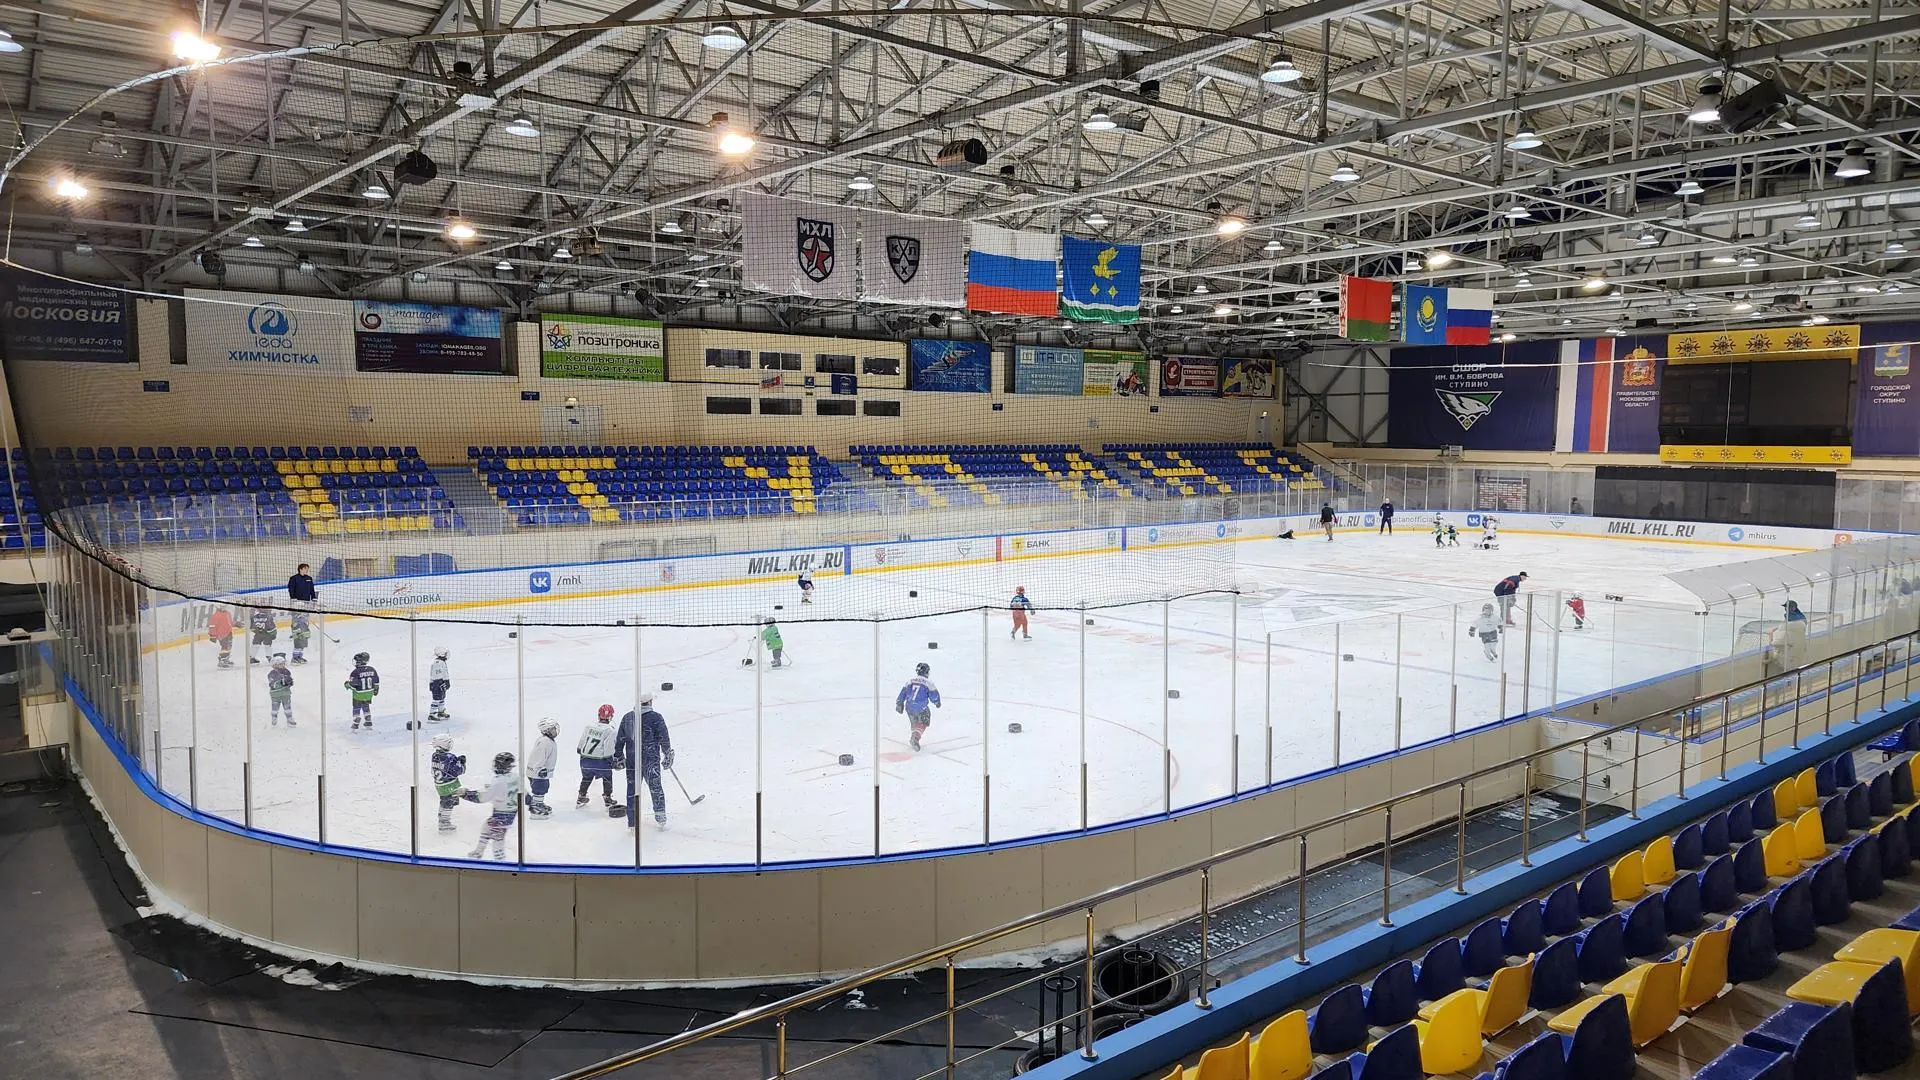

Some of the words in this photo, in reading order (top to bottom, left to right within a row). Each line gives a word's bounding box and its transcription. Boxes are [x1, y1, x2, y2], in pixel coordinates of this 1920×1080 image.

[799, 221, 832, 238] МХЛ
[17, 285, 118, 298] Многопрофильный
[91, 299, 119, 308] центр
[228, 350, 320, 364] ХИМЧИСТКА
[612, 366, 660, 376] ТЕХНИКА
[1608, 521, 1696, 538] MHL.KHL.RU
[1026, 539, 1050, 549] БАНК
[366, 593, 441, 608] ЧЕРНОГОЛОВКА
[361, 677, 372, 690] 10
[912, 684, 921, 700] 7
[582, 736, 601, 755] 17
